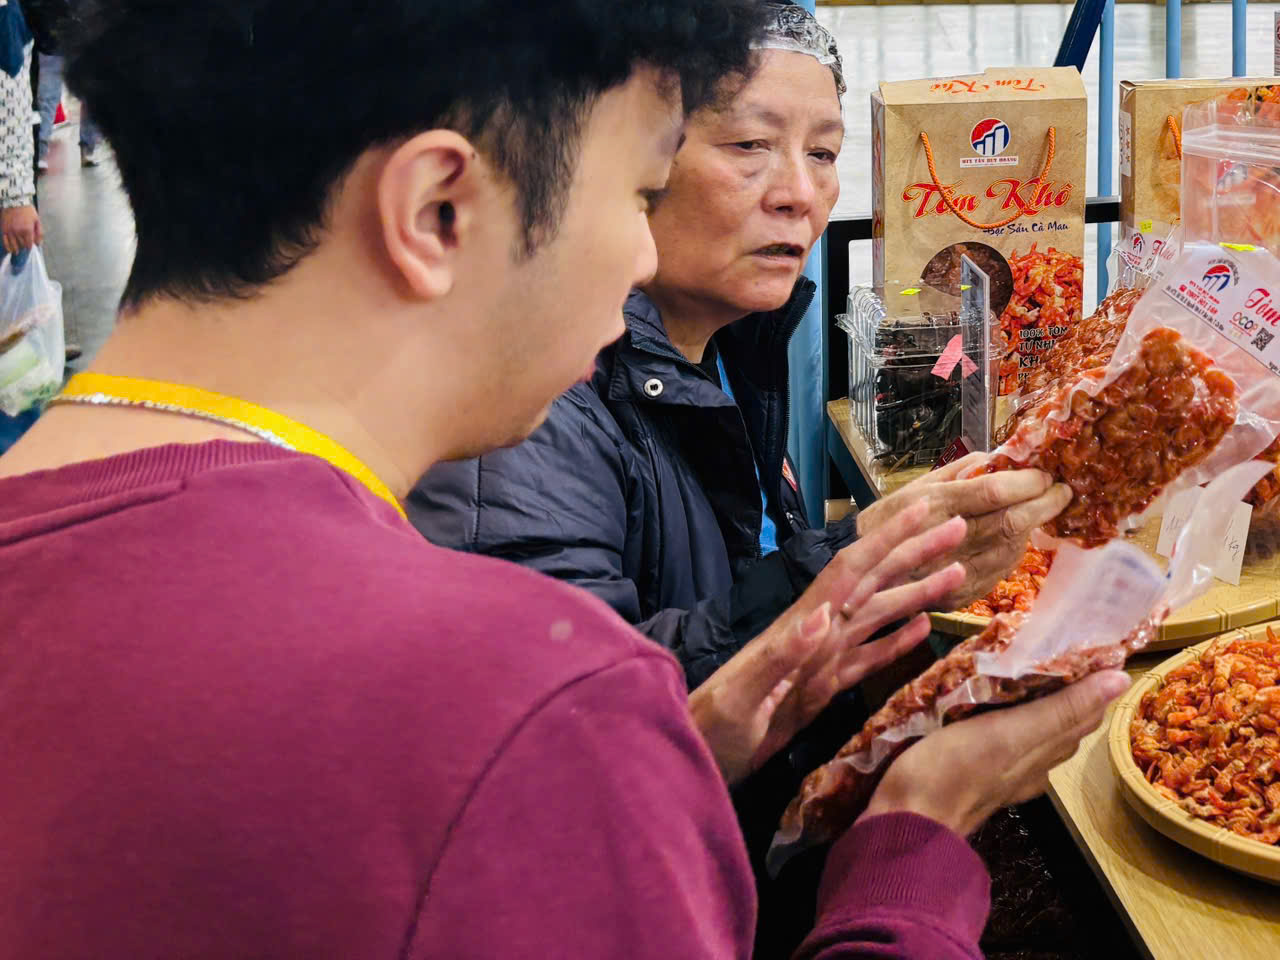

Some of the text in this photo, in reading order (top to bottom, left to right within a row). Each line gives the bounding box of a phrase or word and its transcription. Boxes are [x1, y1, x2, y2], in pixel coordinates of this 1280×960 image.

[902, 176, 1074, 219] Tôm Khô
[1031, 221, 1045, 232] Cà
[1047, 220, 1069, 232] Mau
[1232, 311, 1259, 333] OCOP
[1019, 327, 1045, 339] 100%
